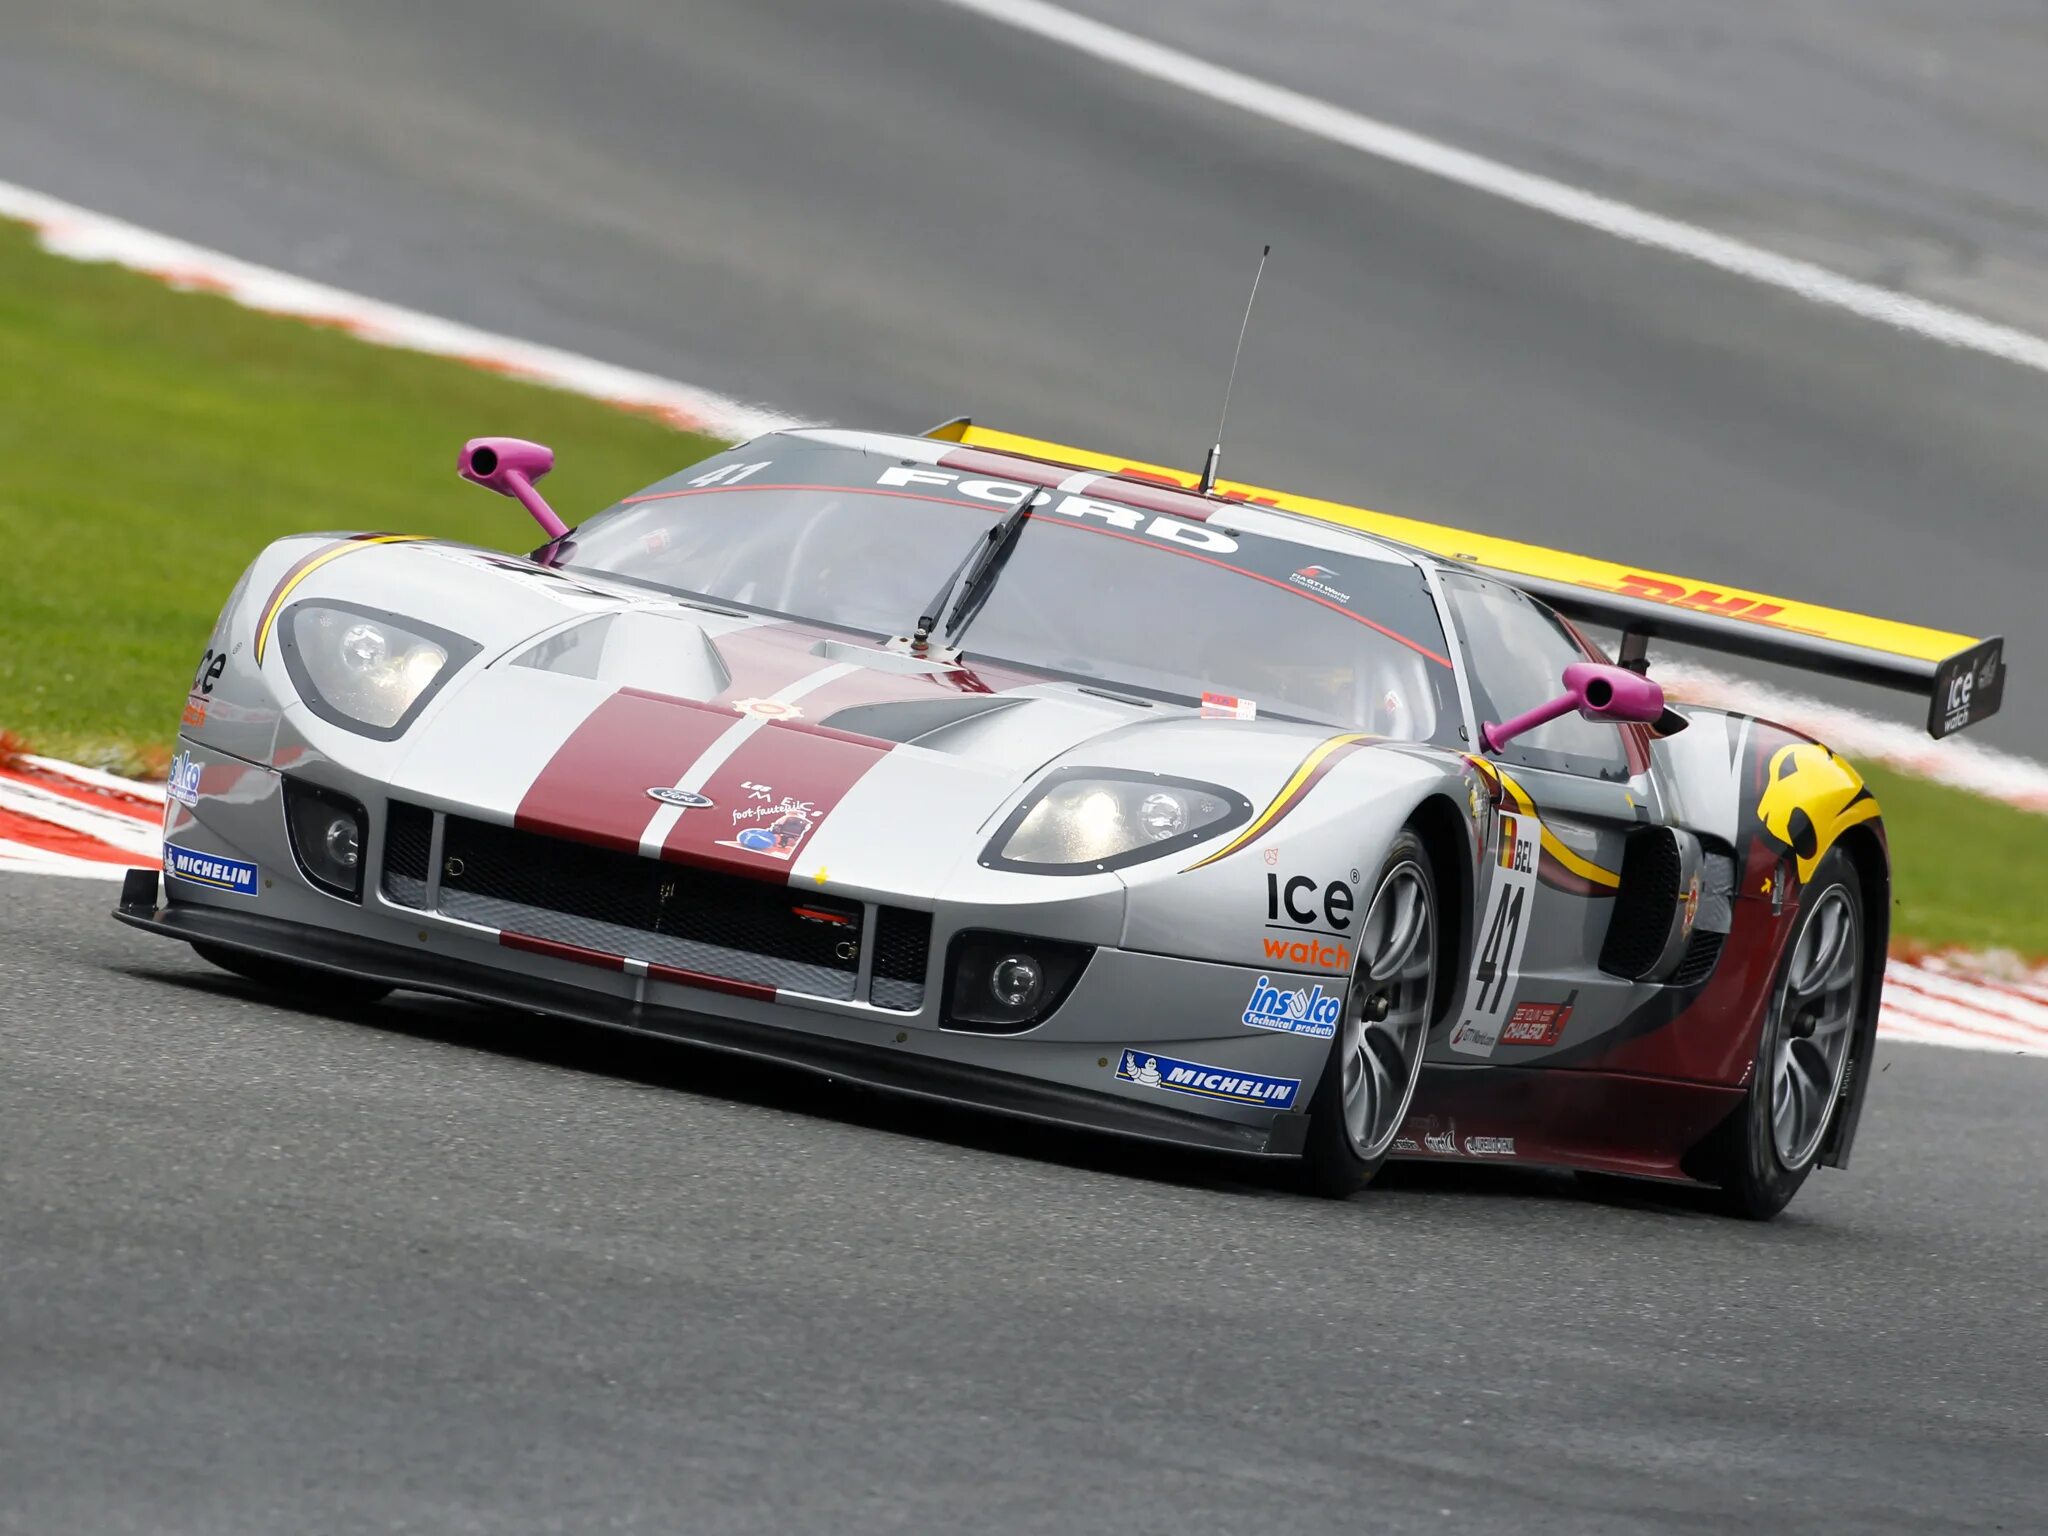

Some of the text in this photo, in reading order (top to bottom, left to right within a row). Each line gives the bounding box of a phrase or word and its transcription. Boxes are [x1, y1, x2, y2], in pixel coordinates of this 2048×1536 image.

[687, 461, 773, 488] 41
[876, 466, 1239, 554] FORD
[1615, 574, 1785, 618] DHL
[1947, 672, 1973, 711] ice
[1944, 708, 1969, 732] watch
[661, 790, 698, 803] Ford
[176, 854, 252, 885] MICHELIN
[1514, 839, 1533, 874] BEL
[1267, 873, 1354, 930] ice
[1263, 938, 1350, 971] watch
[1475, 883, 1526, 1015] 41
[1248, 976, 1340, 1024] insulco
[1248, 1012, 1333, 1038] Technical products
[1166, 1067, 1293, 1101] MICHELIN
